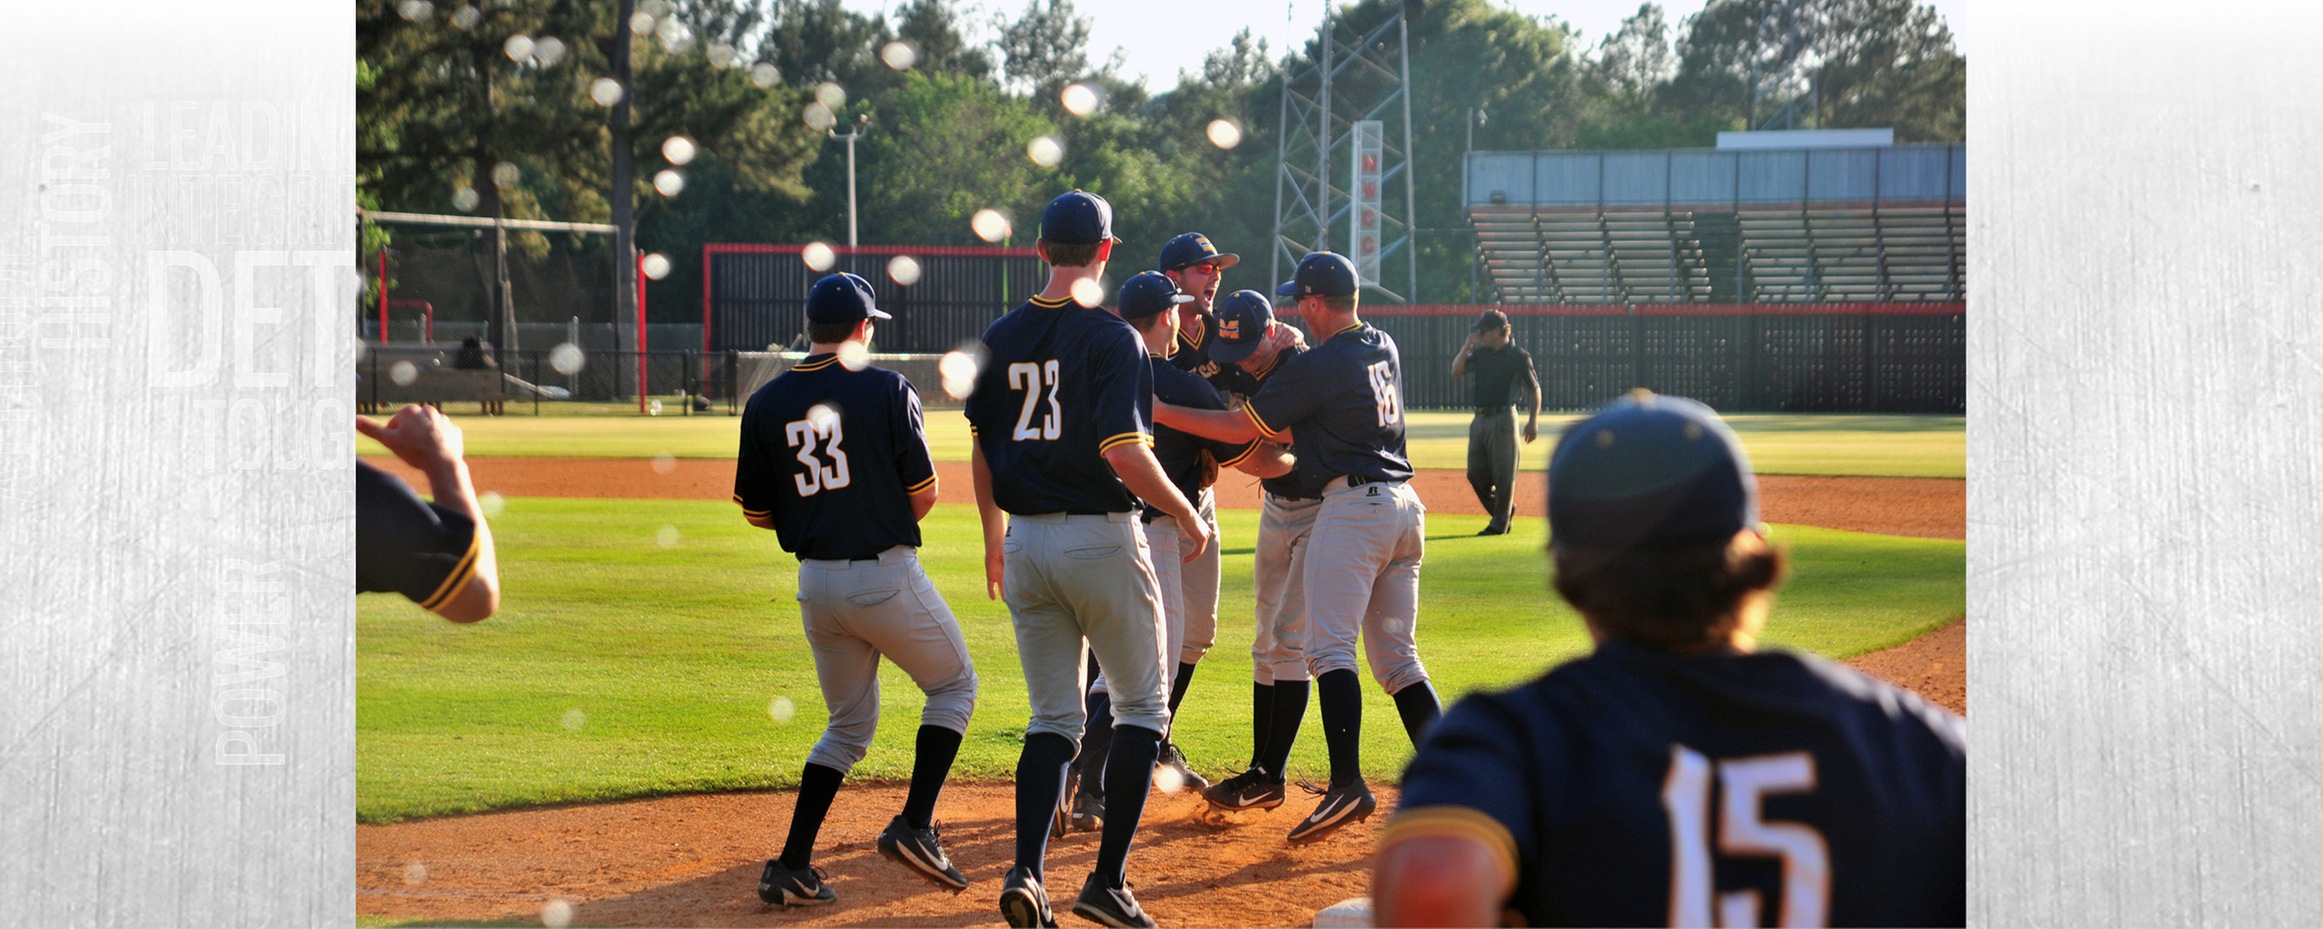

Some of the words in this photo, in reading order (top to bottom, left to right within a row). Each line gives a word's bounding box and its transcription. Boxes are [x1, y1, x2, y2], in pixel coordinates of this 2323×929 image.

[1008, 359, 1062, 442] 23
[1367, 359, 1400, 428] 16
[785, 411, 850, 497] 33
[1660, 743, 1833, 927] 15
